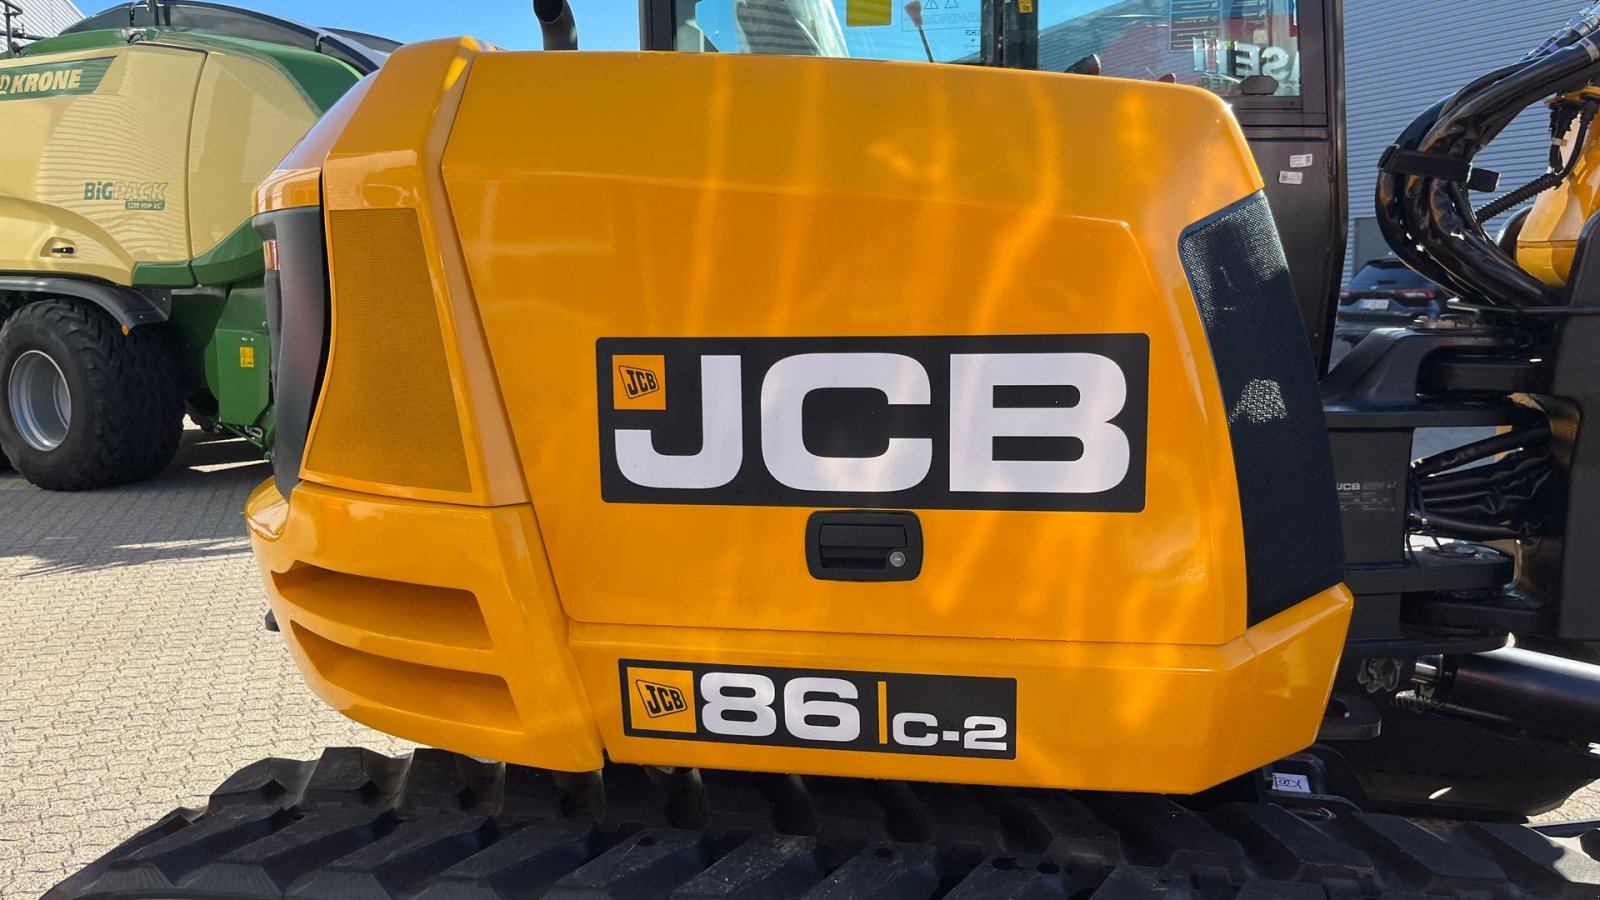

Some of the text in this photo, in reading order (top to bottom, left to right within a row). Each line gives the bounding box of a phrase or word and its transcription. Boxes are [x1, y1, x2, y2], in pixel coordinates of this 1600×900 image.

[10, 69, 83, 94] KRONE
[626, 368, 659, 396] JCB
[614, 352, 1130, 493] JCB
[1336, 482, 1360, 491] JCB
[646, 671, 1008, 751] JCB 86 C-2
